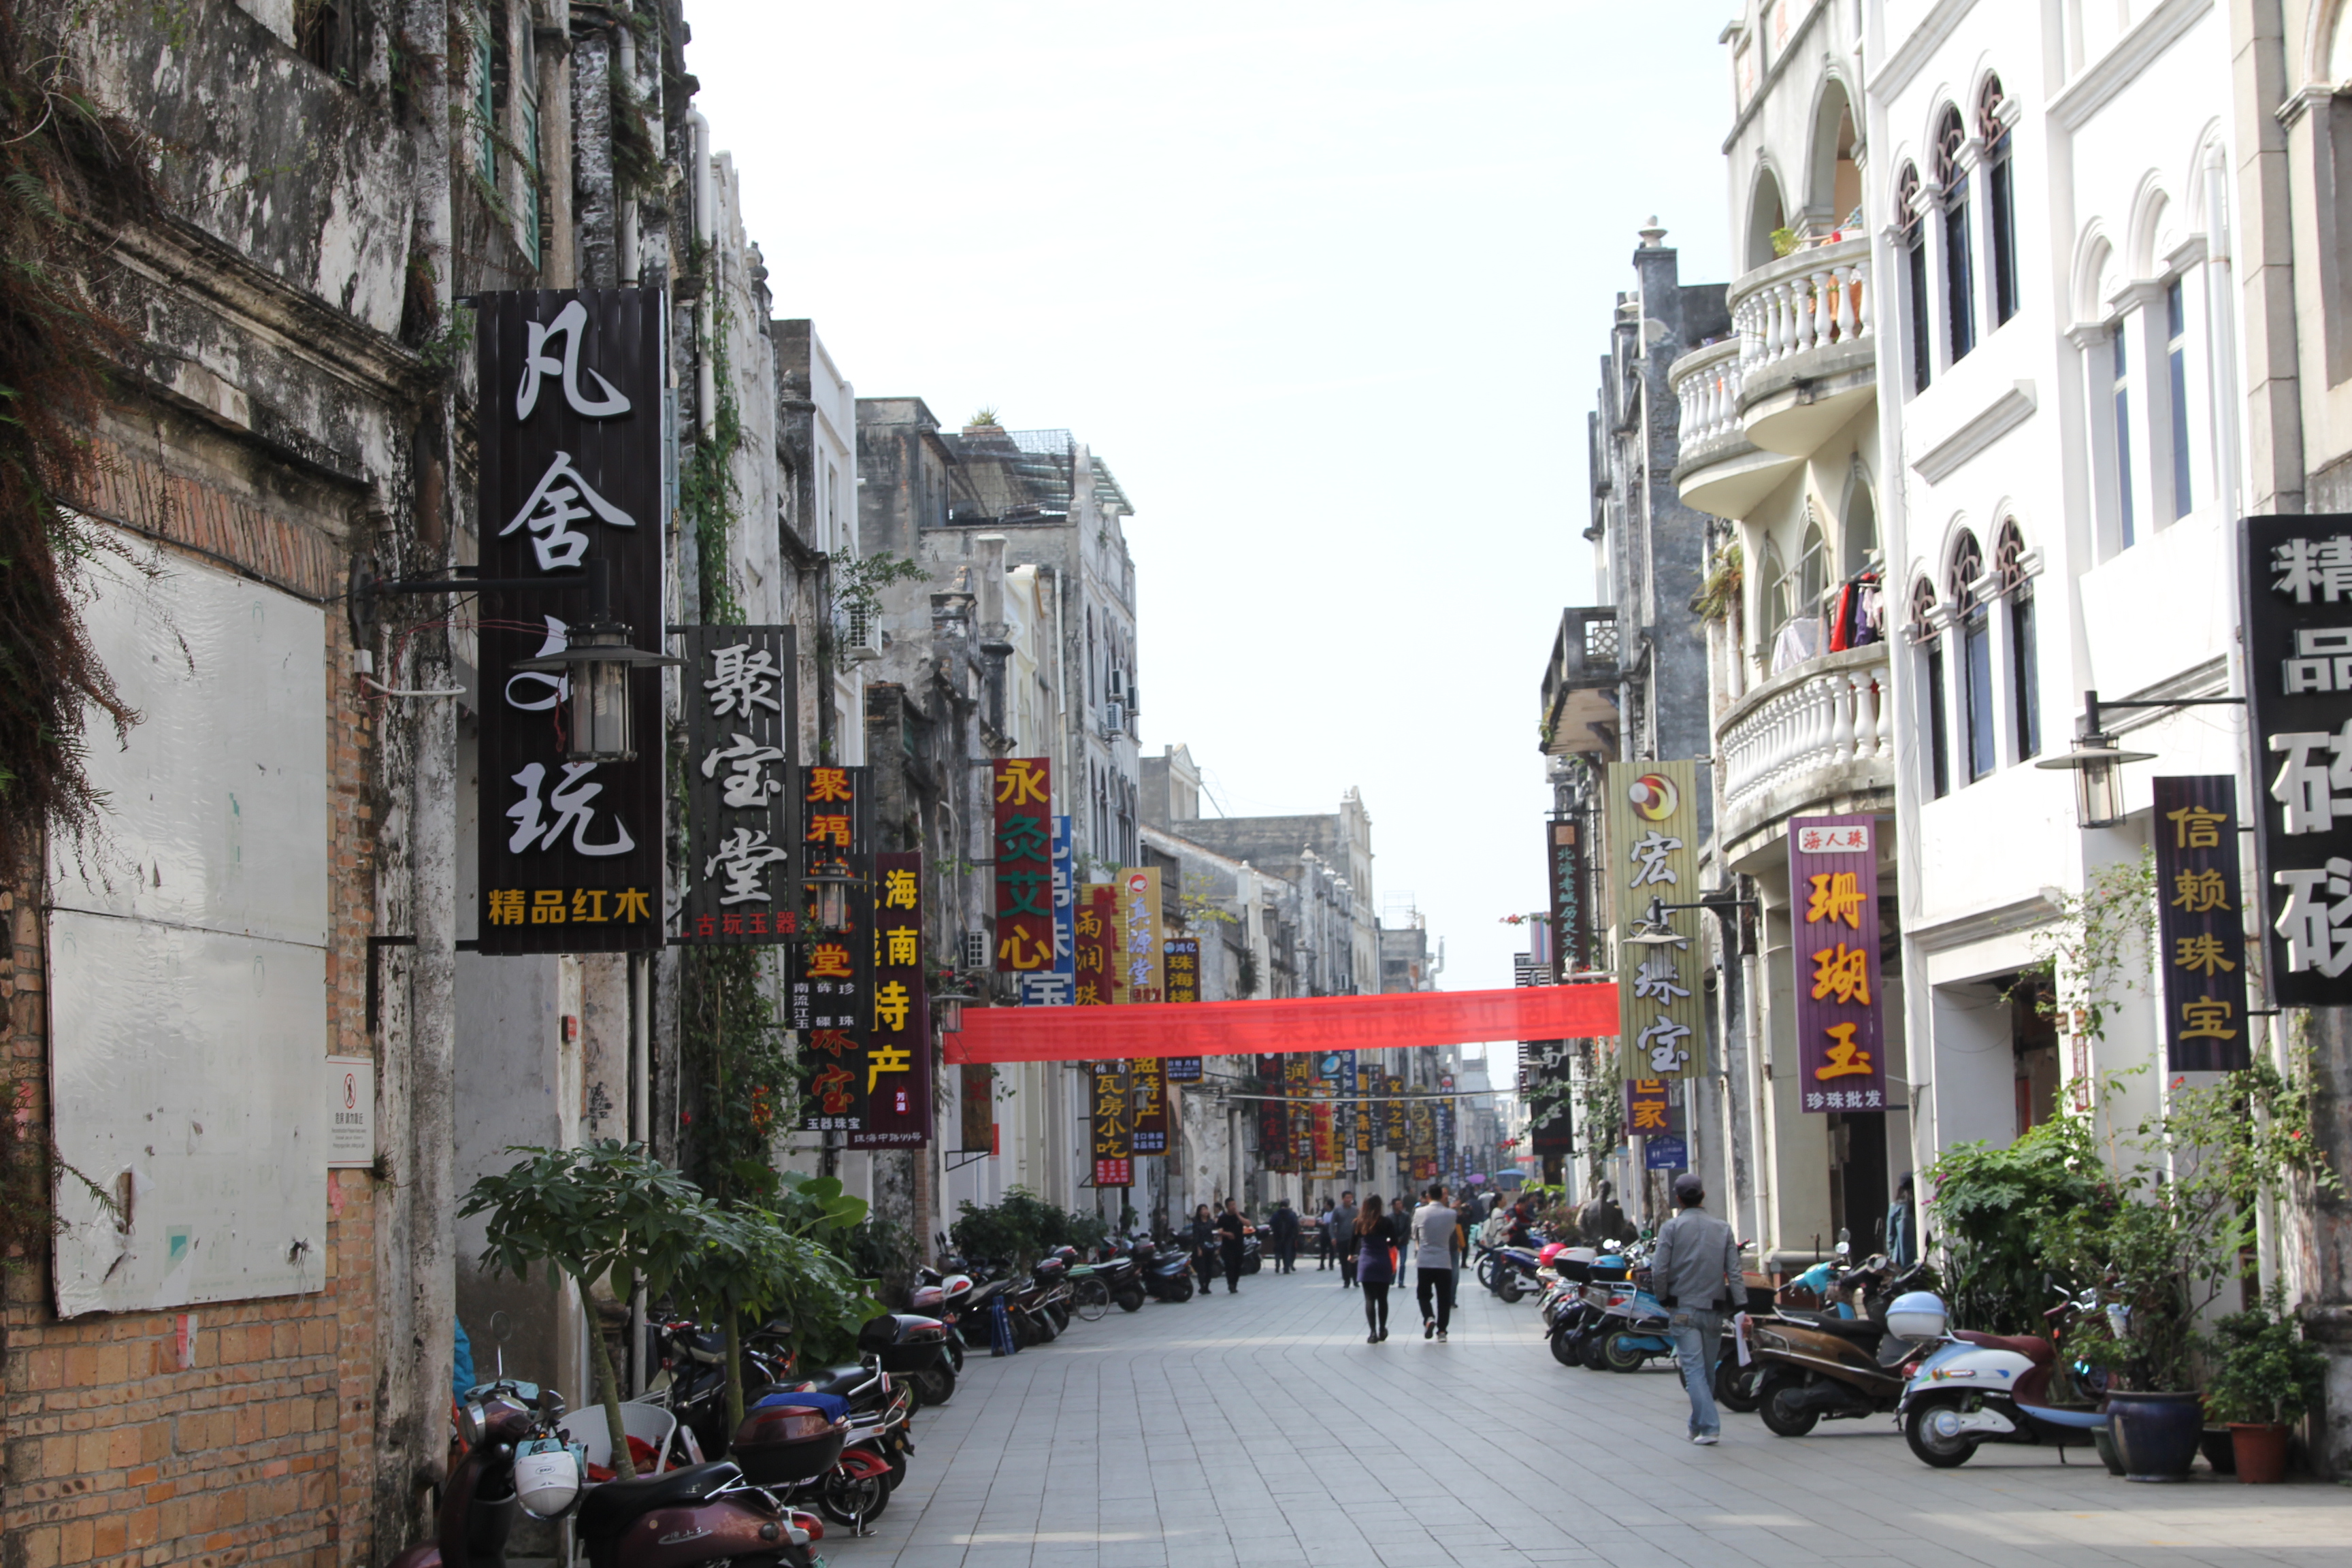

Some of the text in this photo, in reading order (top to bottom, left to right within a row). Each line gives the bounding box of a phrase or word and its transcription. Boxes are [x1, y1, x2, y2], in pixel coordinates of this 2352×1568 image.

[702, 643, 787, 906] 聚宝堂
[488, 888, 650, 926] 精品红木
[696, 911, 797, 936] 古玩玉器
[806, 767, 853, 978] 聚福堂
[996, 759, 1052, 969] 永灸艾心
[2167, 806, 2237, 1041] 信赖珠宝
[868, 868, 922, 1096] 海南特产
[1128, 897, 1154, 985] 真源堂
[1806, 872, 1874, 1081] 珊瑚玉
[807, 1117, 860, 1130] 玉器珠宝
[1096, 1074, 1128, 1158] 瓦房小吃
[1806, 1090, 1882, 1109] 珍珠批发
